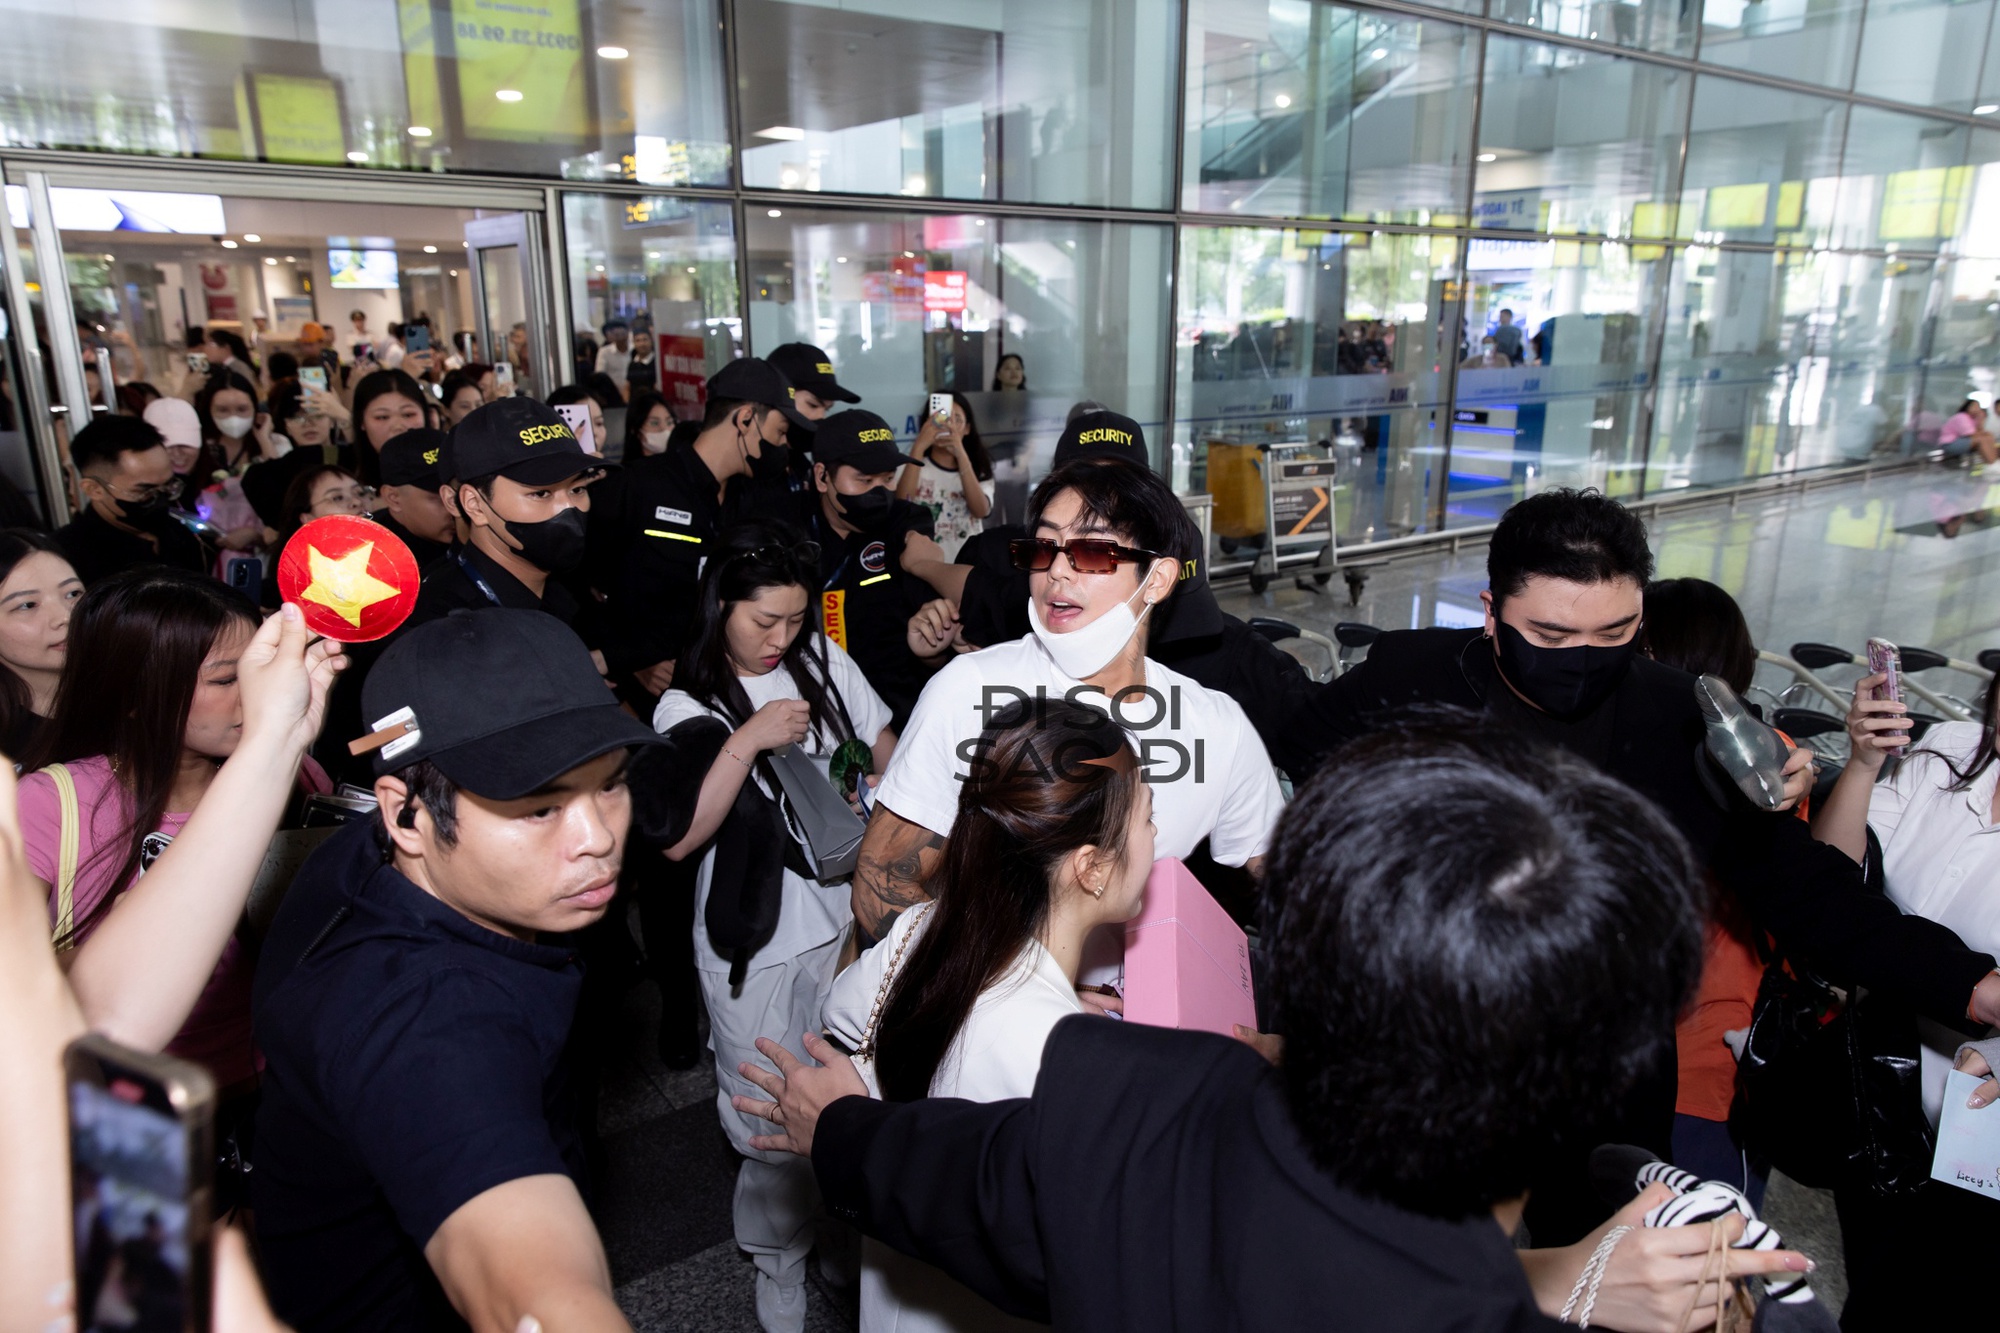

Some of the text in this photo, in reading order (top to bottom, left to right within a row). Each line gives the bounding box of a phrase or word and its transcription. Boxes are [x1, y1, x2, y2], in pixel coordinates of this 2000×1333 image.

[1079, 428, 1133, 446] SECURITY
[1179, 559, 1197, 580] ITY
[826, 594, 840, 643] SEC
